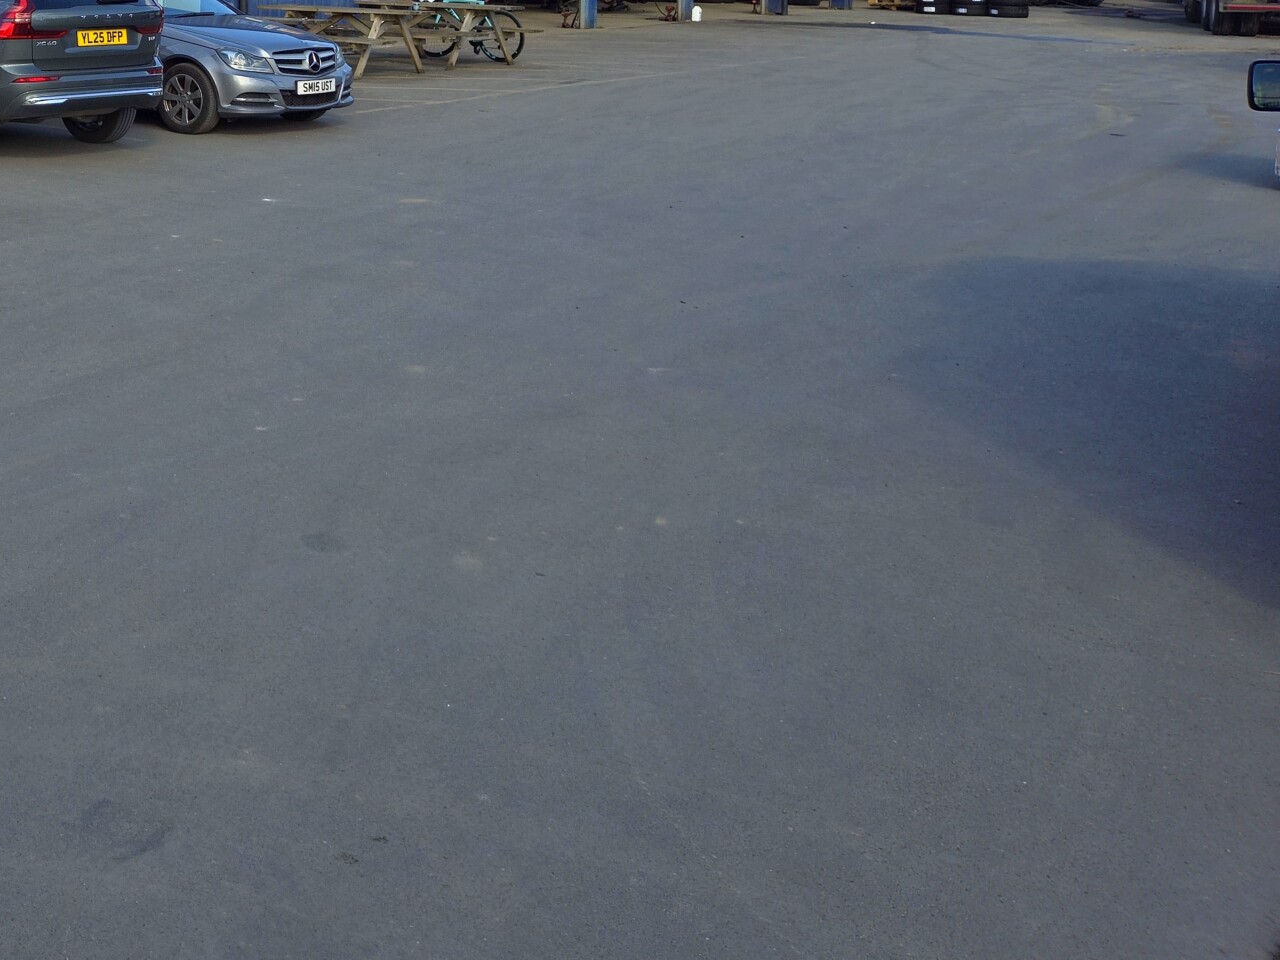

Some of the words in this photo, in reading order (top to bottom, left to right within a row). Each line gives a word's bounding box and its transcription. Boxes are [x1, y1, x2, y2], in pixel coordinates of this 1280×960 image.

[81, 31, 105, 44] YL25
[106, 30, 123, 43] DFP
[303, 81, 320, 93] SM15
[320, 80, 333, 91] UST
